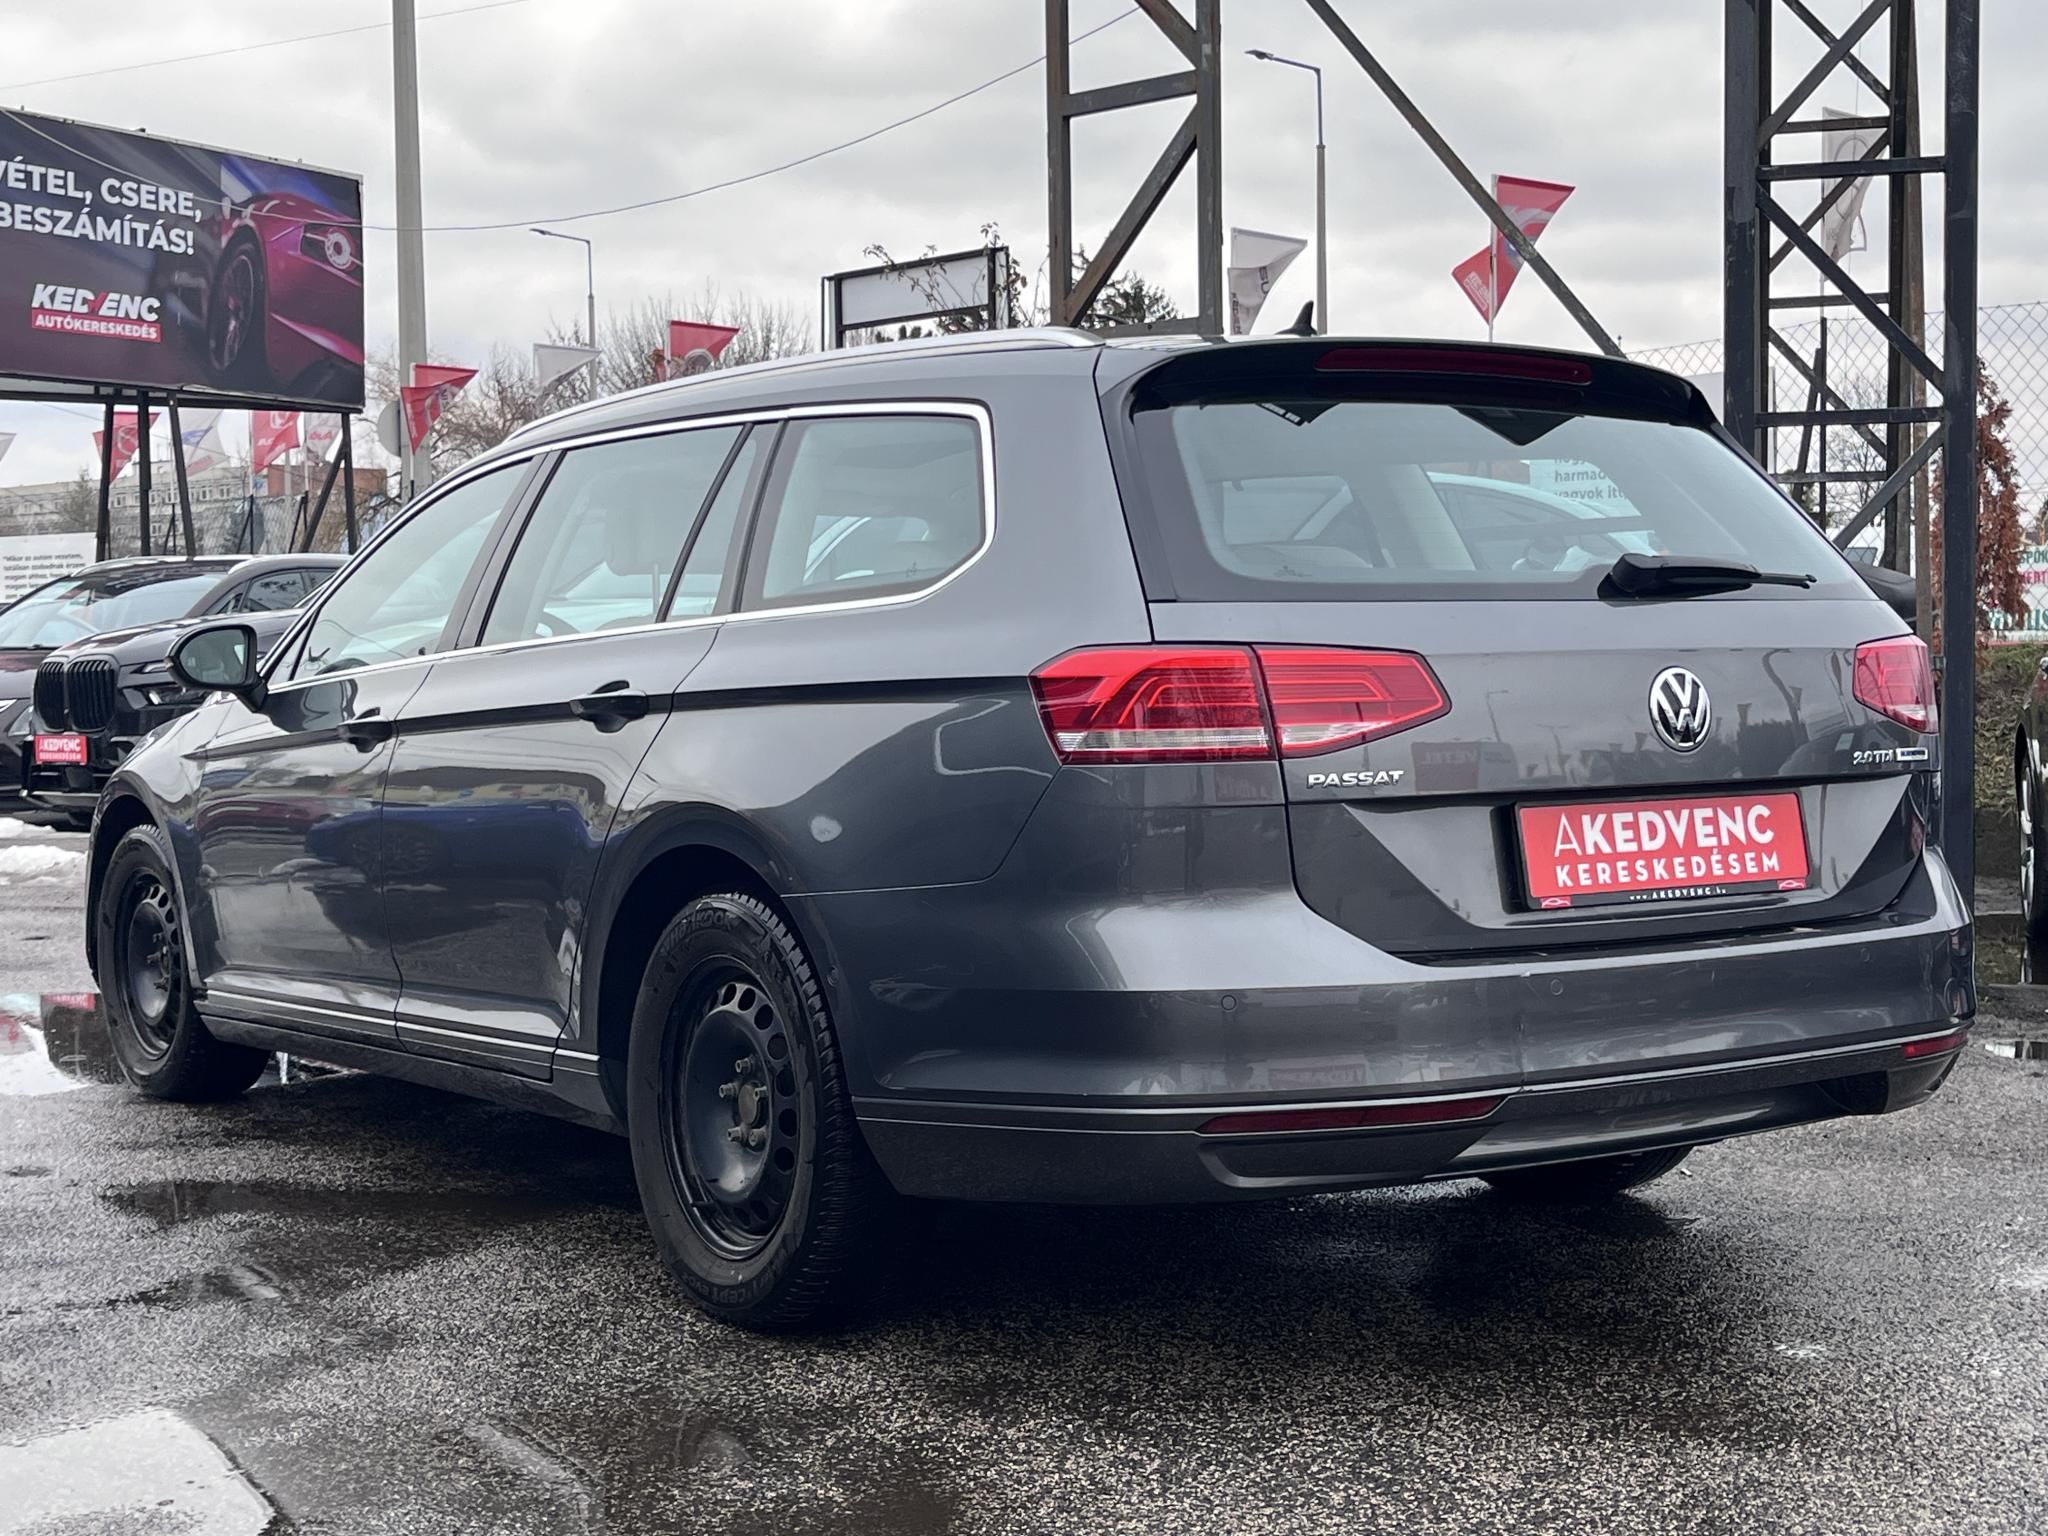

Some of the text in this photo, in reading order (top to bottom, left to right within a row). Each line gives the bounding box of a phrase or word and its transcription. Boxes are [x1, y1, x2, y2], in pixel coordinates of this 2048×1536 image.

[101, 178, 202, 222] CSERE,
[0, 200, 195, 255] BESZÁMÍTÁS!
[35, 313, 158, 340] AUTÓKERESKEDÉS
[1306, 770, 1404, 789] PASSAT
[1555, 848, 1780, 888] KERESKEDÉSEM
